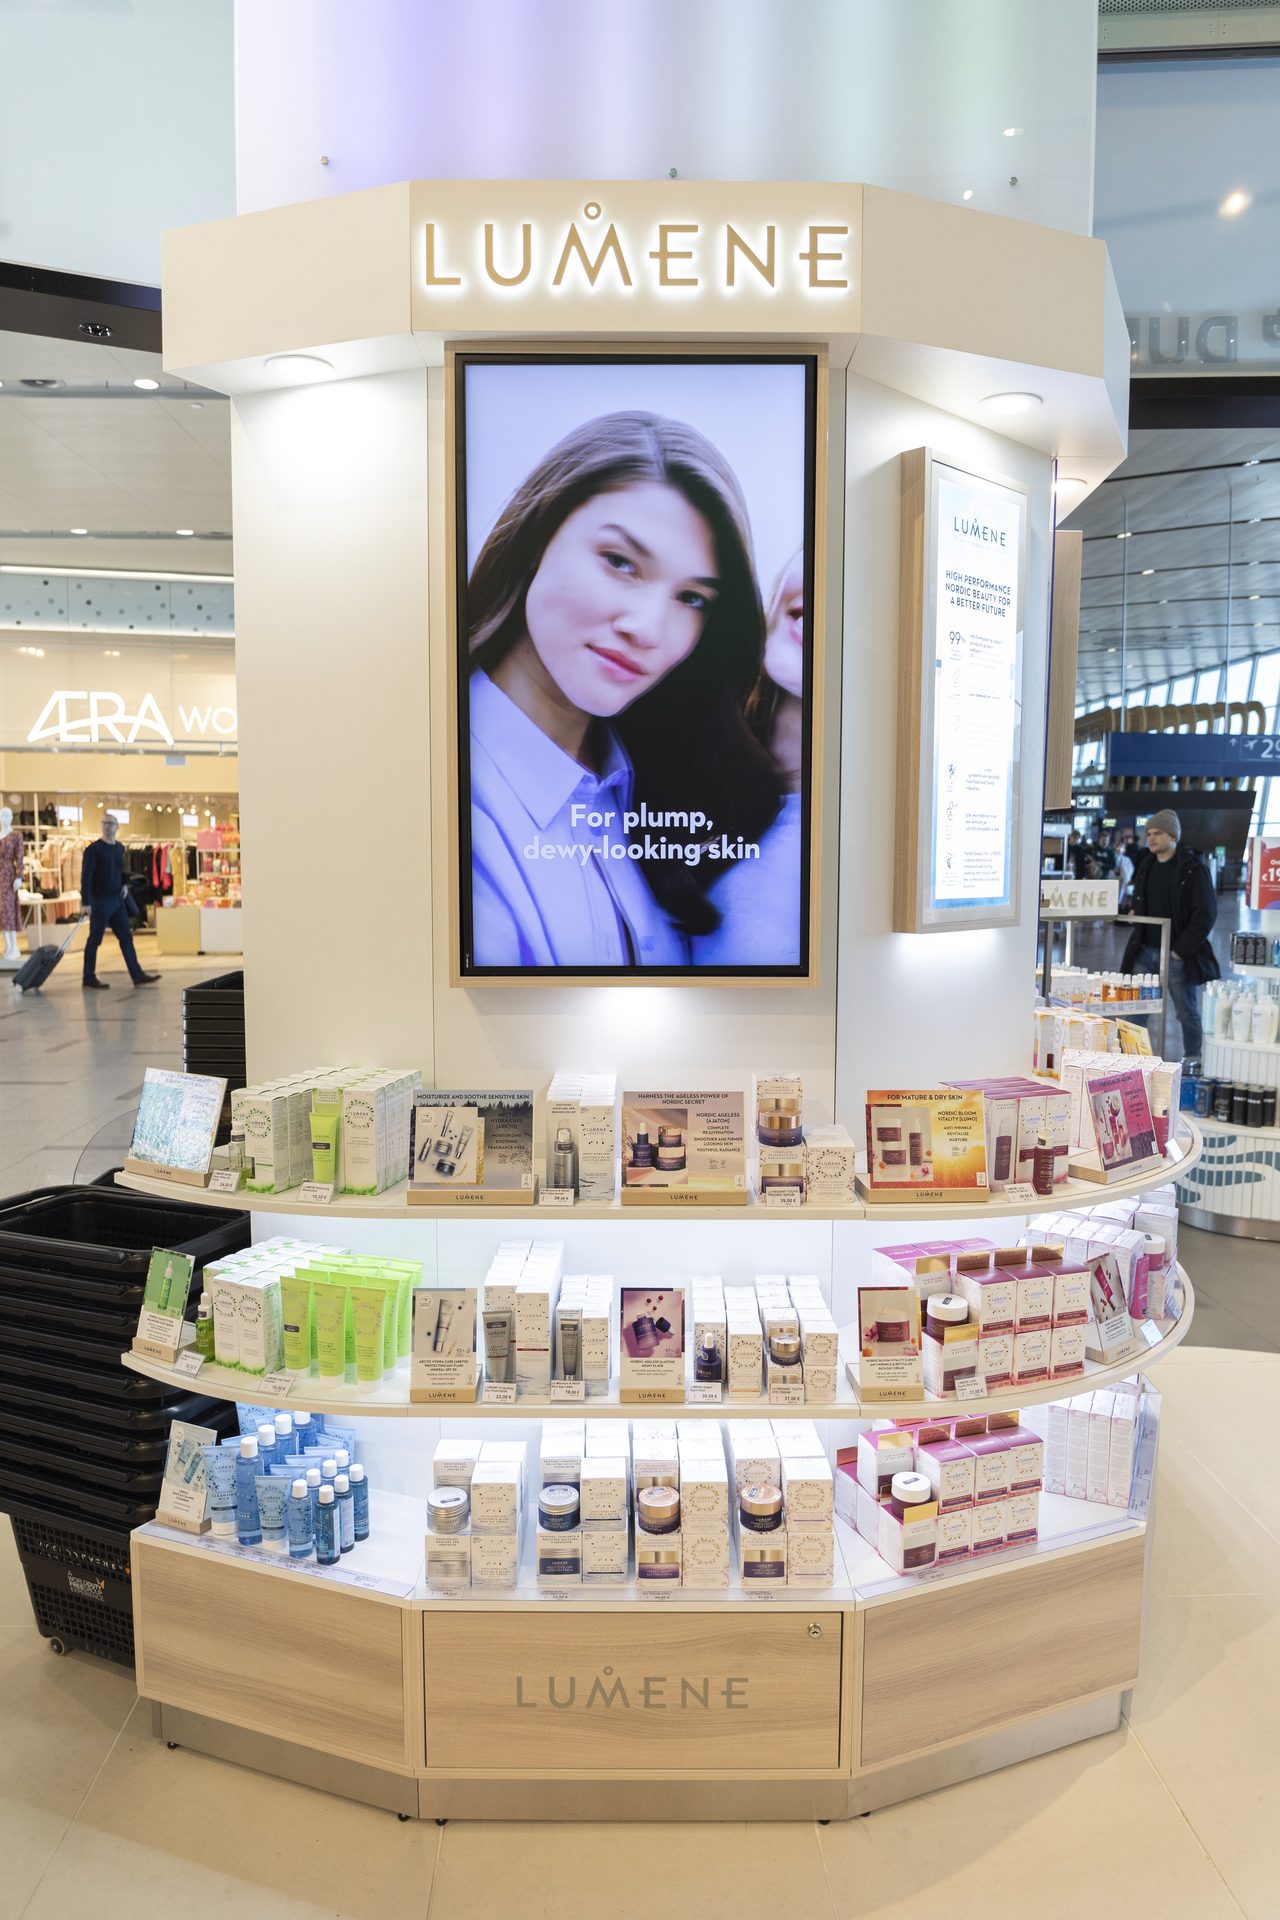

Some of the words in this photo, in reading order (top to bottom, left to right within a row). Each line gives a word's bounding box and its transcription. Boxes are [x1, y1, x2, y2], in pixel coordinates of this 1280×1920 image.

[425, 202, 848, 288] LUMENE
[954, 516, 1006, 546] LUMENE
[946, 570, 962, 582] HIGH
[964, 575, 1011, 595] PERFORMANCE
[946, 582, 970, 597] NORDIC
[972, 588, 997, 603] BEAUTY
[998, 596, 1011, 606] FOR
[950, 596, 955, 605] A
[956, 597, 980, 611] BETTER
[982, 603, 1006, 618] FUTURE
[570, 804, 615, 828] For
[623, 802, 713, 834] plump,
[523, 834, 700, 867] dewy-looking
[708, 834, 760, 859] skin
[516, 1666, 749, 1709] LUMENE
